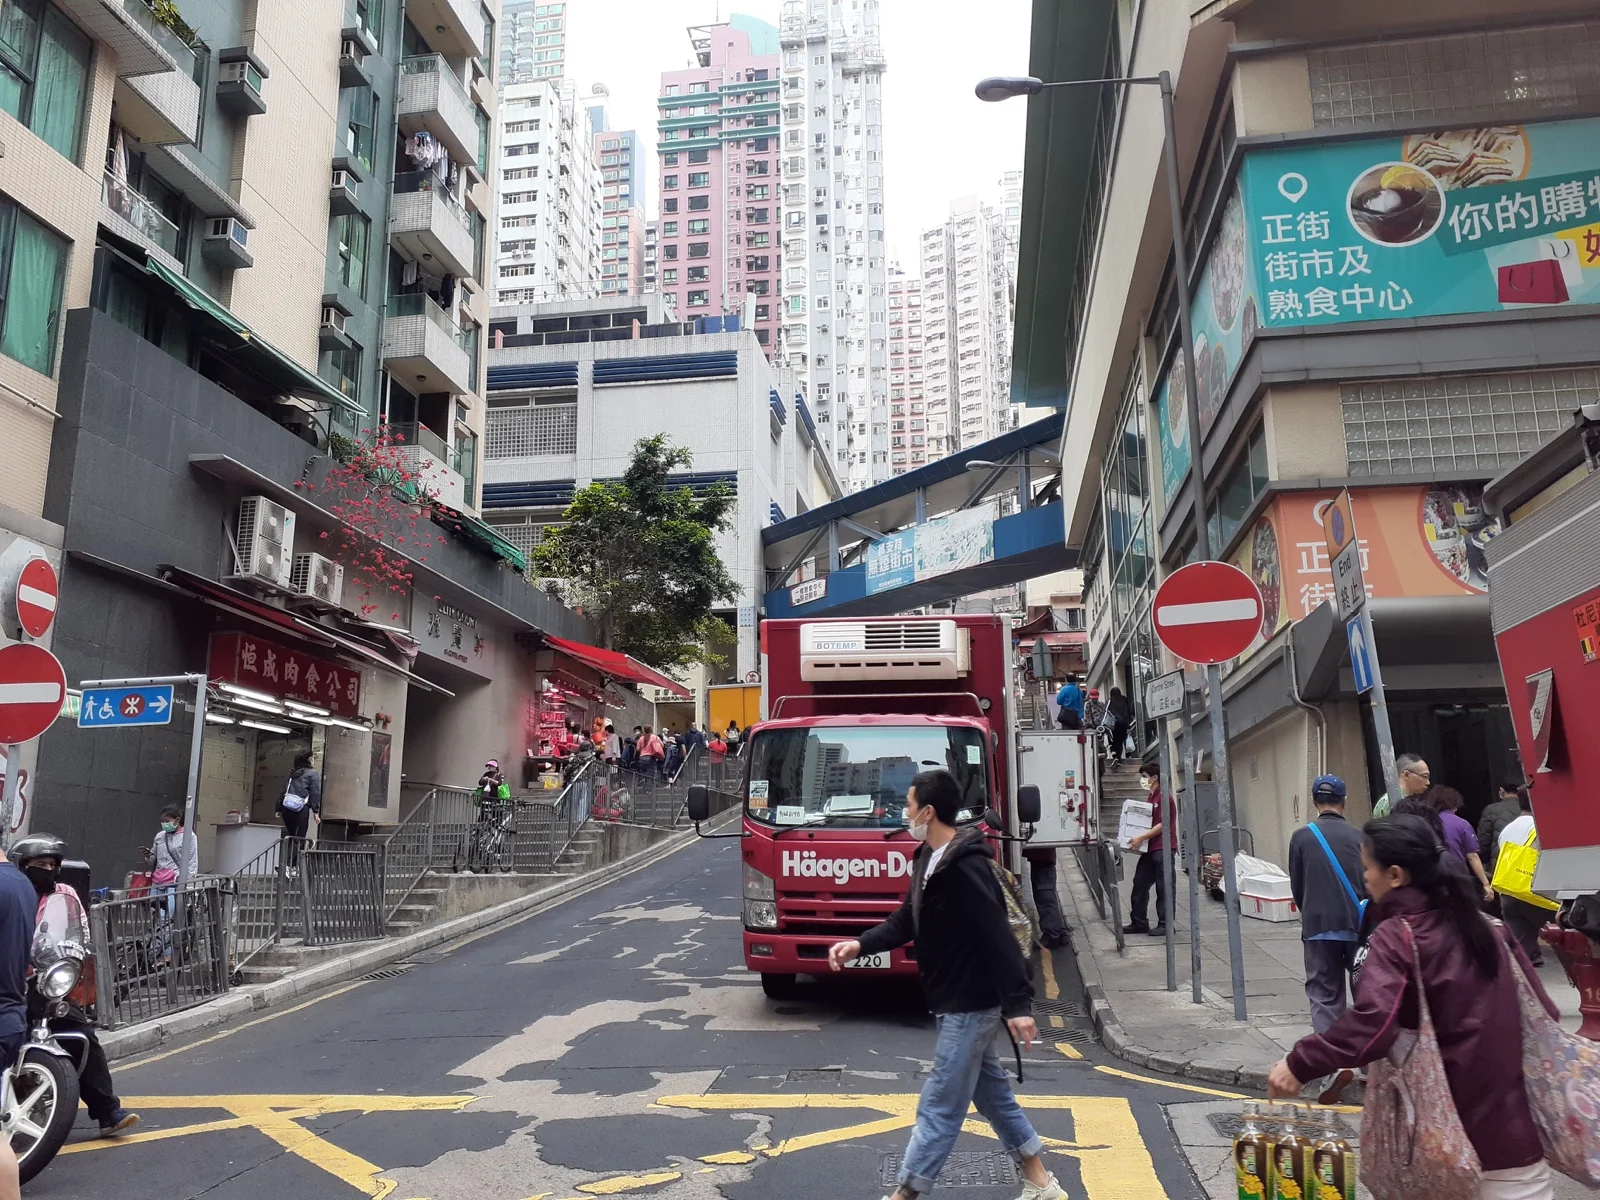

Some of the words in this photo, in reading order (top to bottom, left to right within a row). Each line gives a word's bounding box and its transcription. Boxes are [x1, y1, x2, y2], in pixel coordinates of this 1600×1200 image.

[1261, 211, 1331, 245] 正街
[1264, 245, 1372, 282] 街市及
[1267, 281, 1413, 320] 熟食中心
[1339, 553, 1352, 577] End
[1341, 577, 1360, 612] 終止
[1575, 601, 1600, 628] 杜尼
[816, 642, 857, 650] BOTEMP
[241, 642, 359, 705] 恒成肉食公司
[1152, 683, 1164, 694] Centre
[1164, 679, 1176, 690] Street
